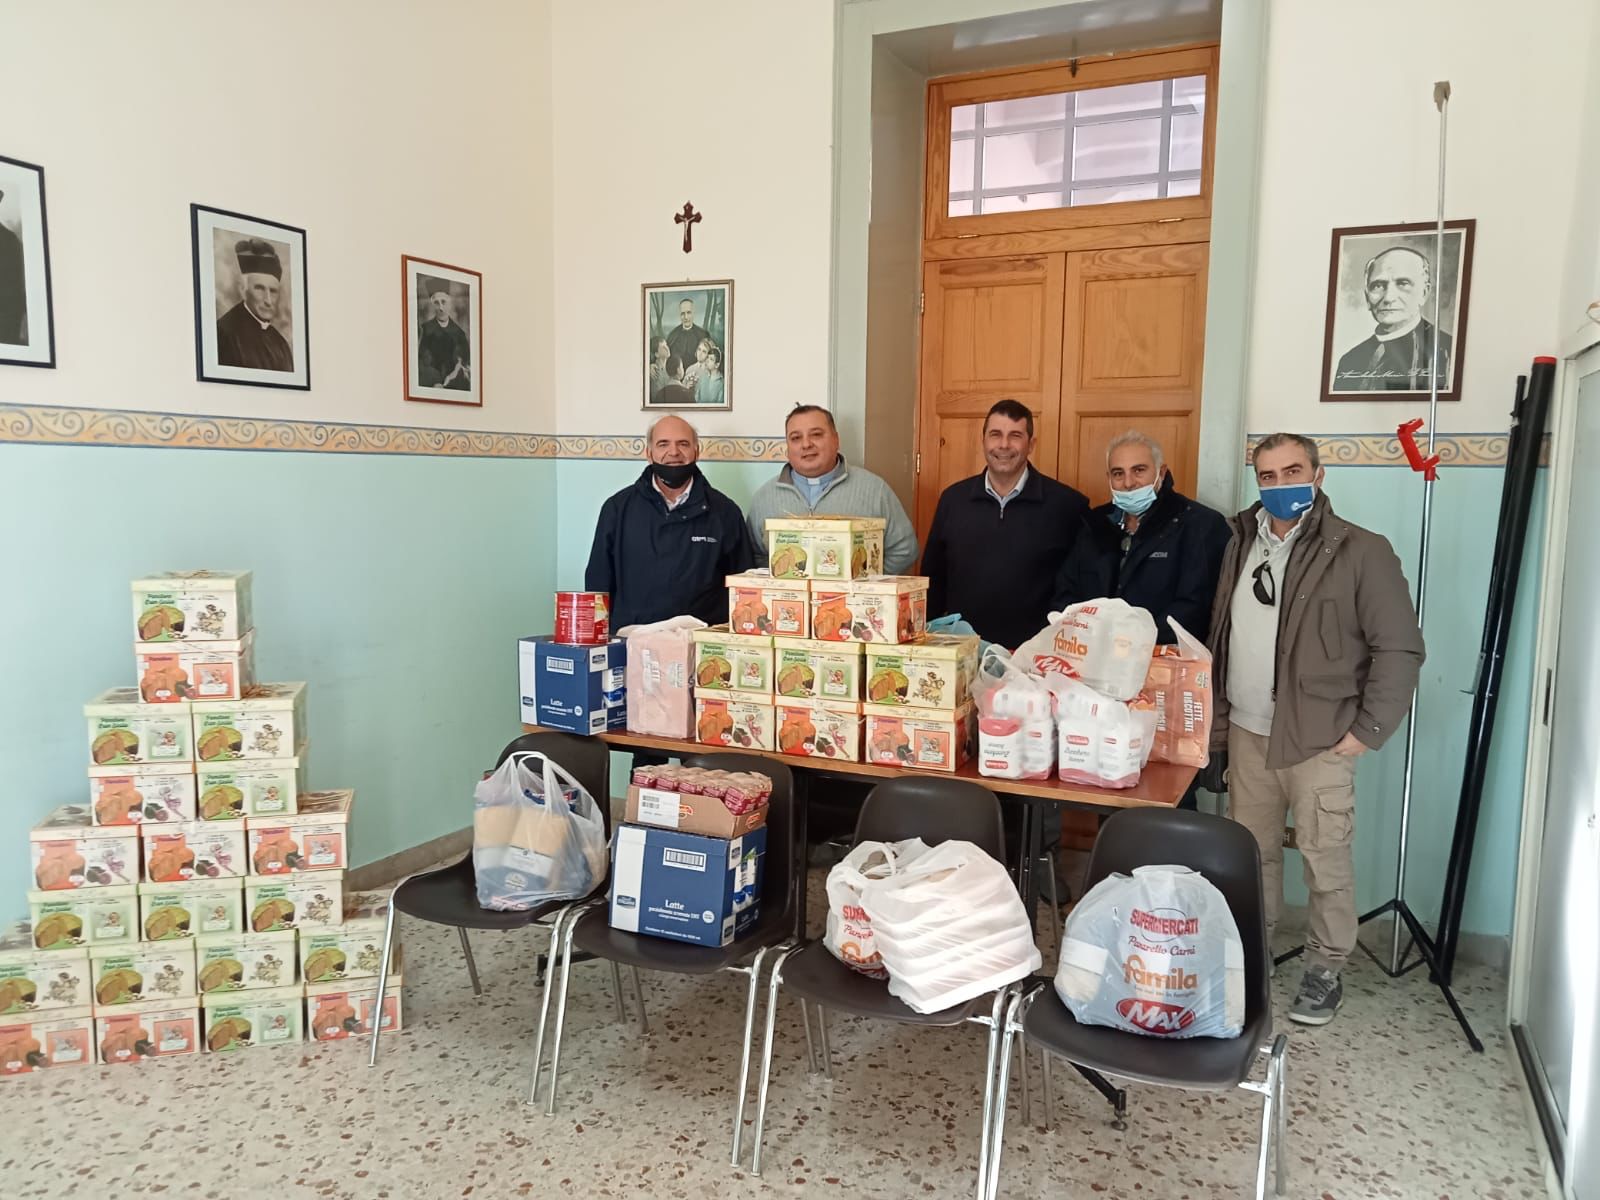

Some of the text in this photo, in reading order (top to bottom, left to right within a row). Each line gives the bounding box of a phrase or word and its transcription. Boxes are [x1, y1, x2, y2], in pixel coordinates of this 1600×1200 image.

[1053, 629, 1088, 656] famila
[1183, 691, 1194, 733] BISCOTTATE
[1194, 701, 1203, 722] FETTE
[664, 898, 685, 911] Latte
[1130, 908, 1198, 936] SUPERMERCATI
[1128, 935, 1196, 957] Panarello Carni
[1122, 954, 1198, 990] famila
[1126, 1001, 1188, 1030] MAX
